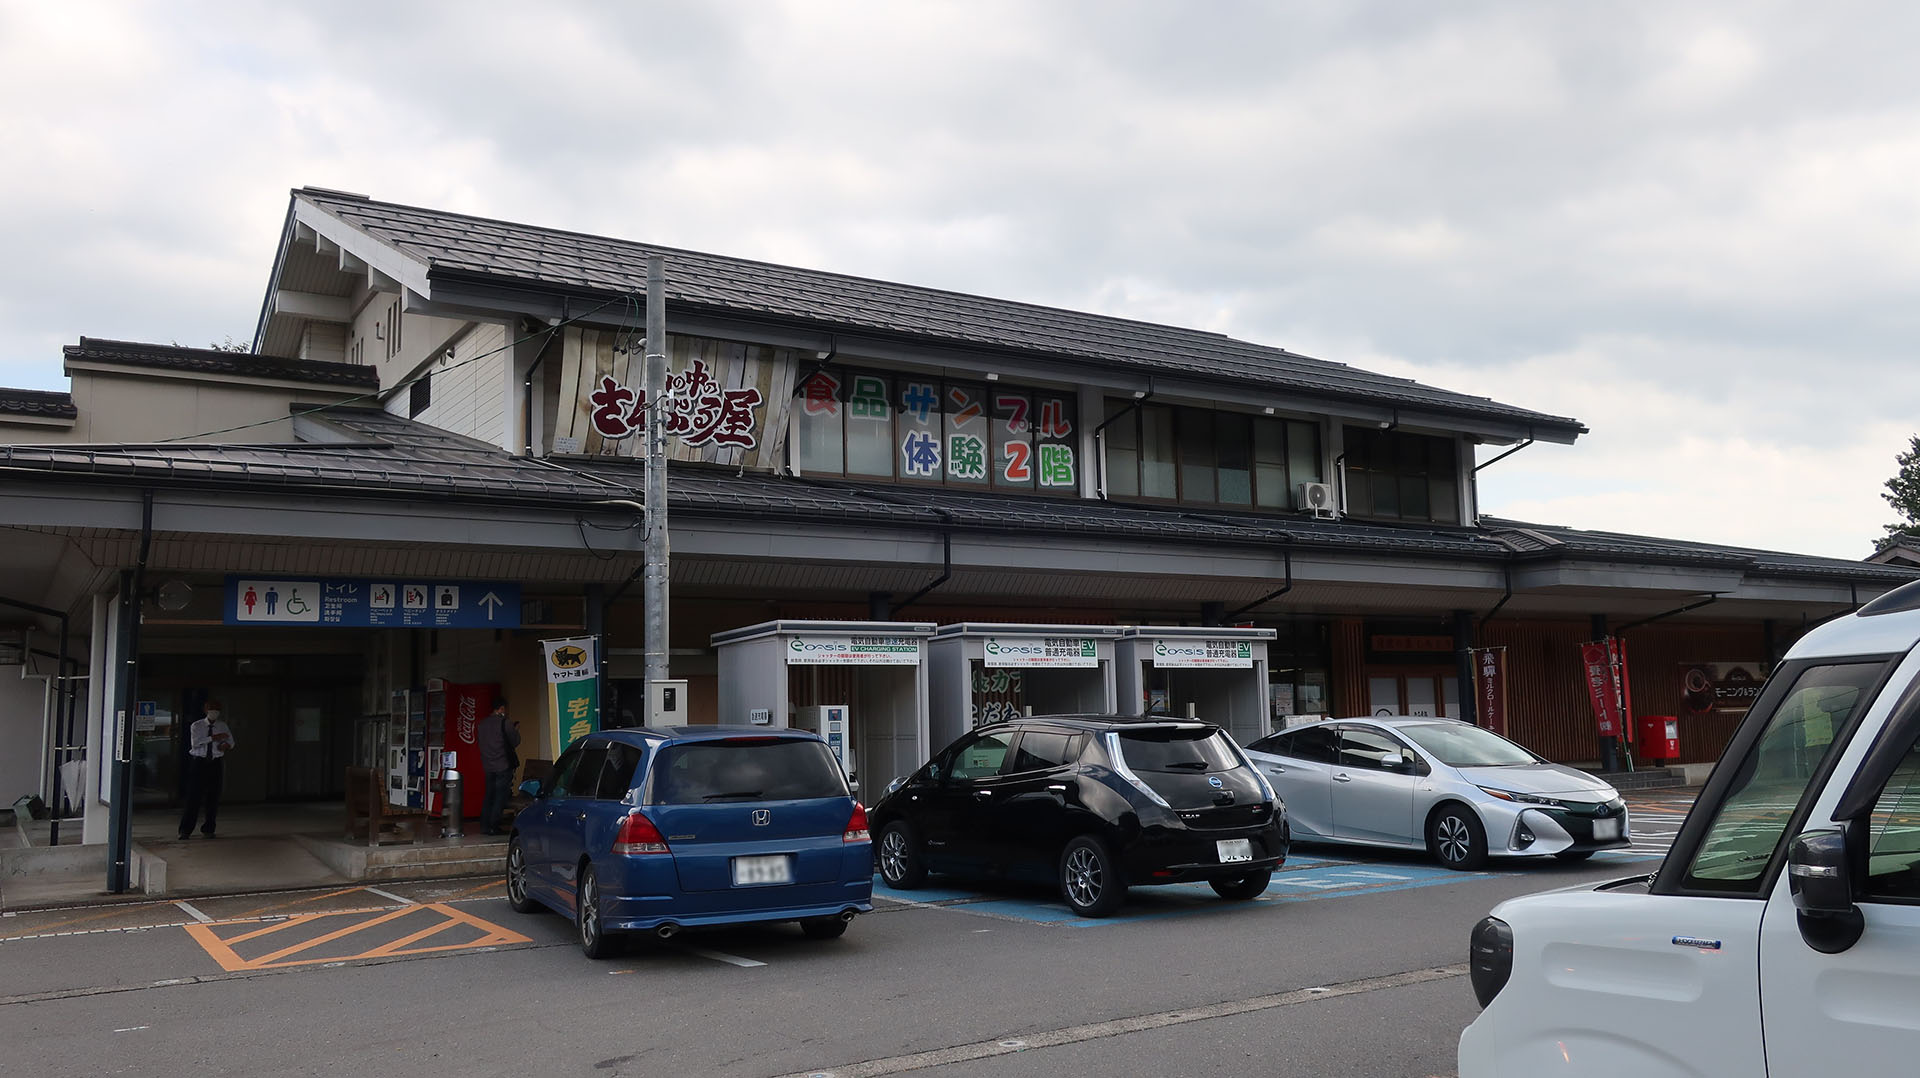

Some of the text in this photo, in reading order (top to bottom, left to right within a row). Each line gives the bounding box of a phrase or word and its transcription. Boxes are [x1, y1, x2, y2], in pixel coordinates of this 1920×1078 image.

[804, 372, 1070, 436] 食品サンプル
[904, 432, 1075, 486] 体験2階
[325, 583, 358, 593] トイレ
[1082, 640, 1095, 650] EV
[1237, 643, 1250, 651] EV
[552, 668, 589, 679] ヤマト運輸
[1715, 687, 1762, 698] モーニング&ラン
[458, 695, 476, 745] Coca-Cola
